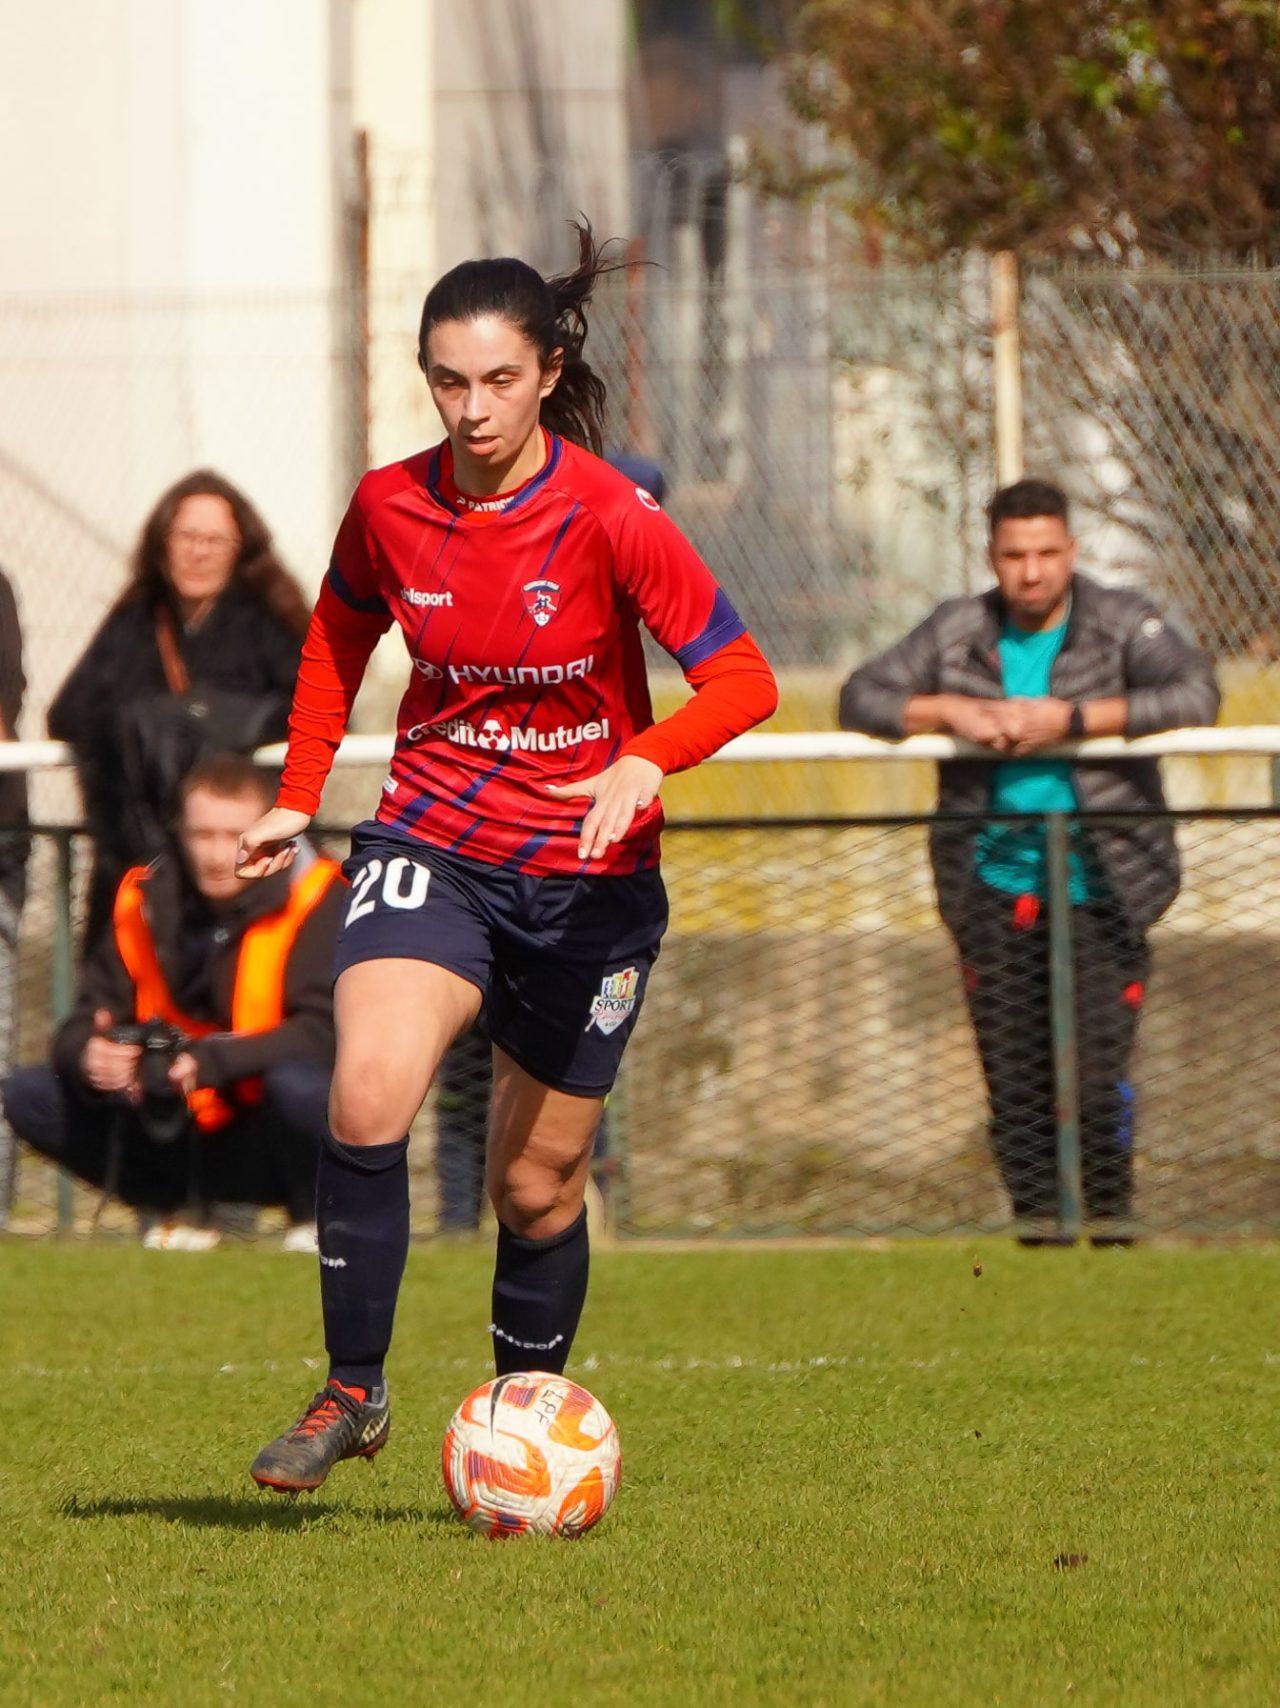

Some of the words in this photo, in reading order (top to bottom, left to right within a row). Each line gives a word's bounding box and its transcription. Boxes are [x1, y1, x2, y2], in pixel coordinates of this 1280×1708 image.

[448, 654, 594, 685] HYUNDAI
[510, 718, 610, 752] Mutuel
[344, 857, 431, 929] 20
[594, 998, 634, 1012] SPORT
